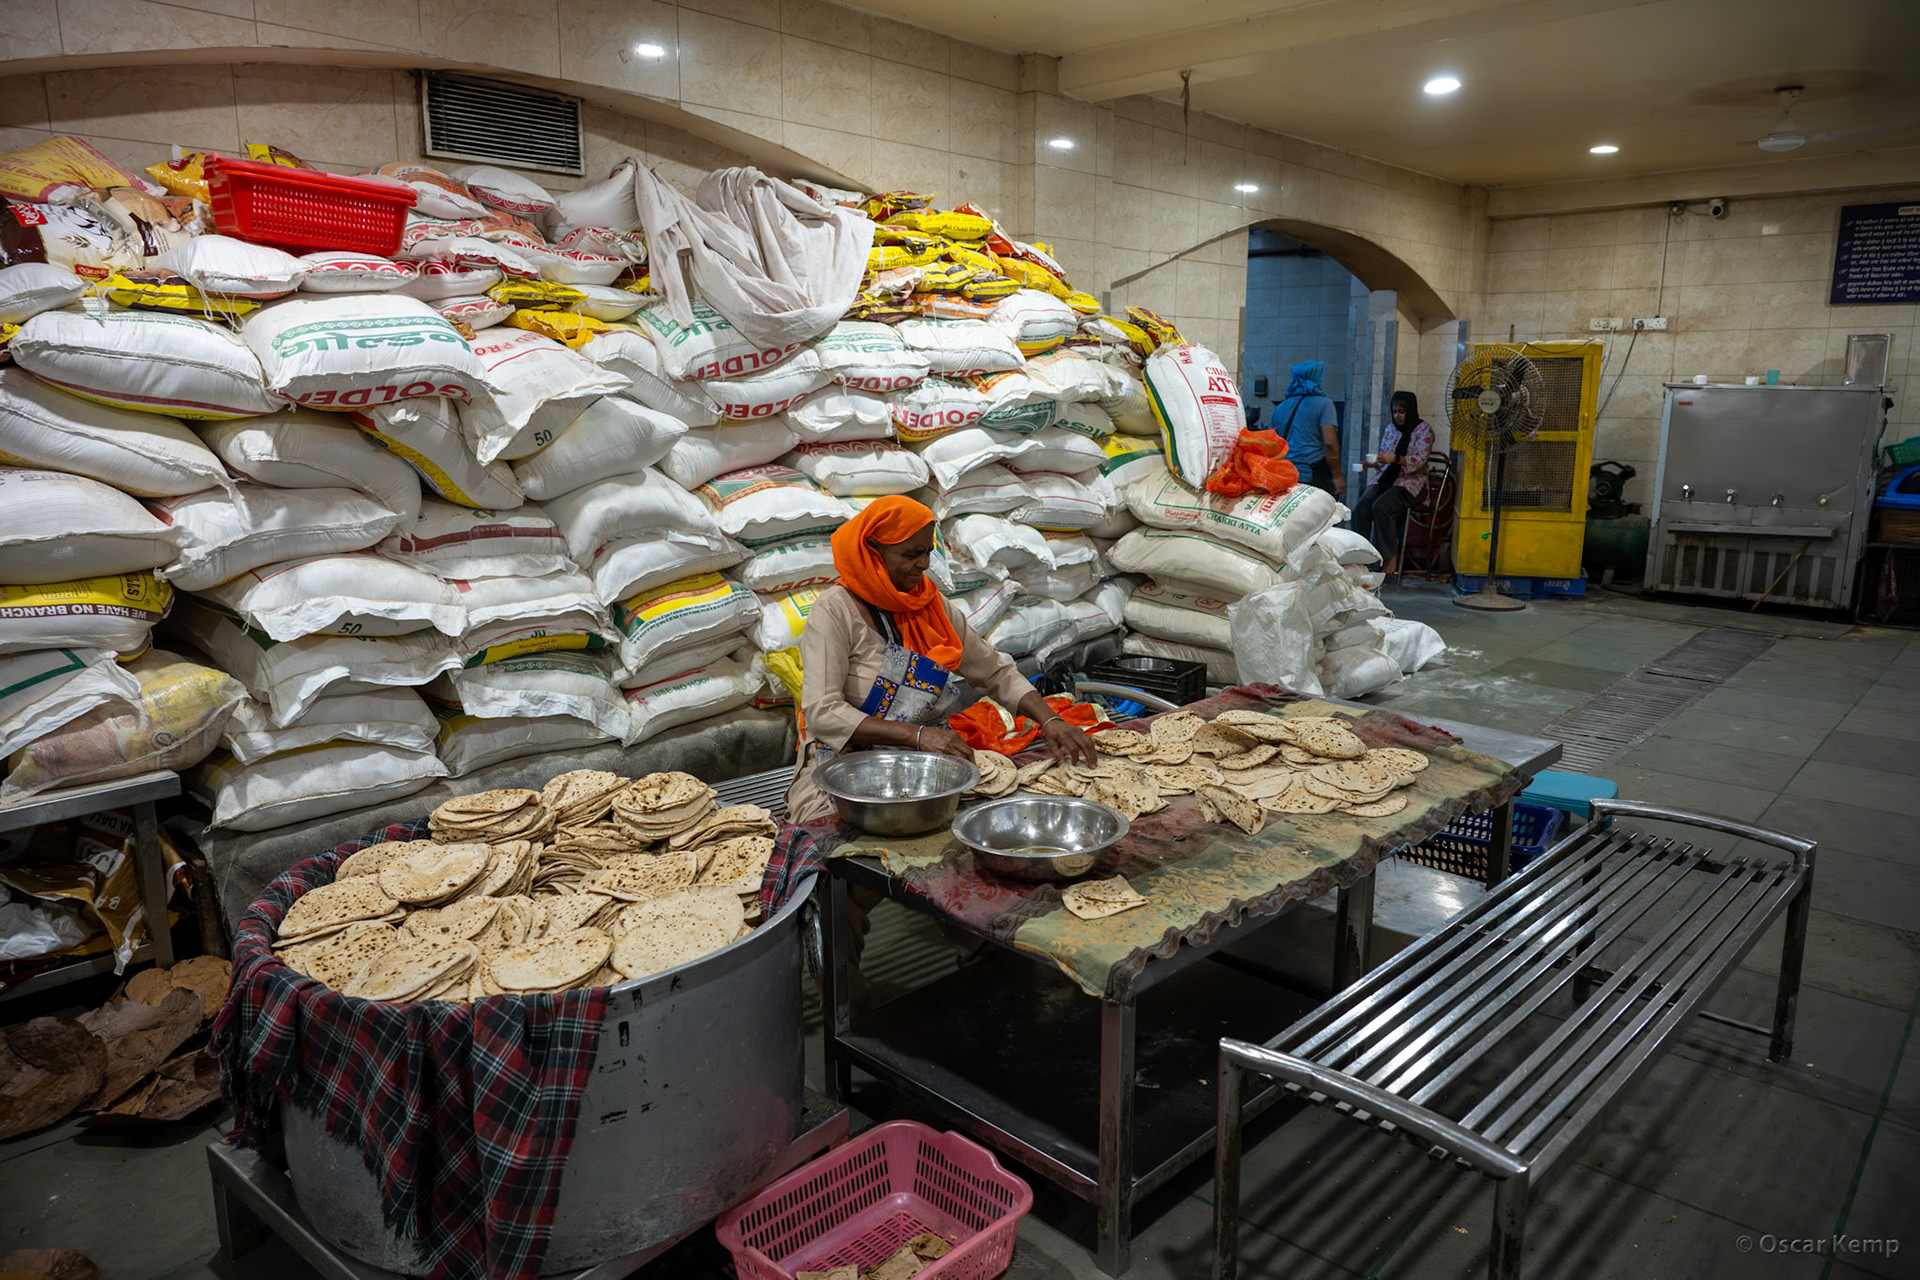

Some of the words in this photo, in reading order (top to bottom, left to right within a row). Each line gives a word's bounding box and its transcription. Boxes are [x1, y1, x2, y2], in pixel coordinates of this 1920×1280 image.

[534, 428, 553, 446] 50
[1205, 512, 1237, 526] CHAKKI
[1238, 522, 1261, 536] ATTA
[71, 604, 93, 615] NO
[96, 604, 129, 617] HAVE
[131, 609, 147, 620] WE
[338, 622, 363, 634] 50
[653, 686, 672, 698] USE
[673, 682, 687, 692] NO
